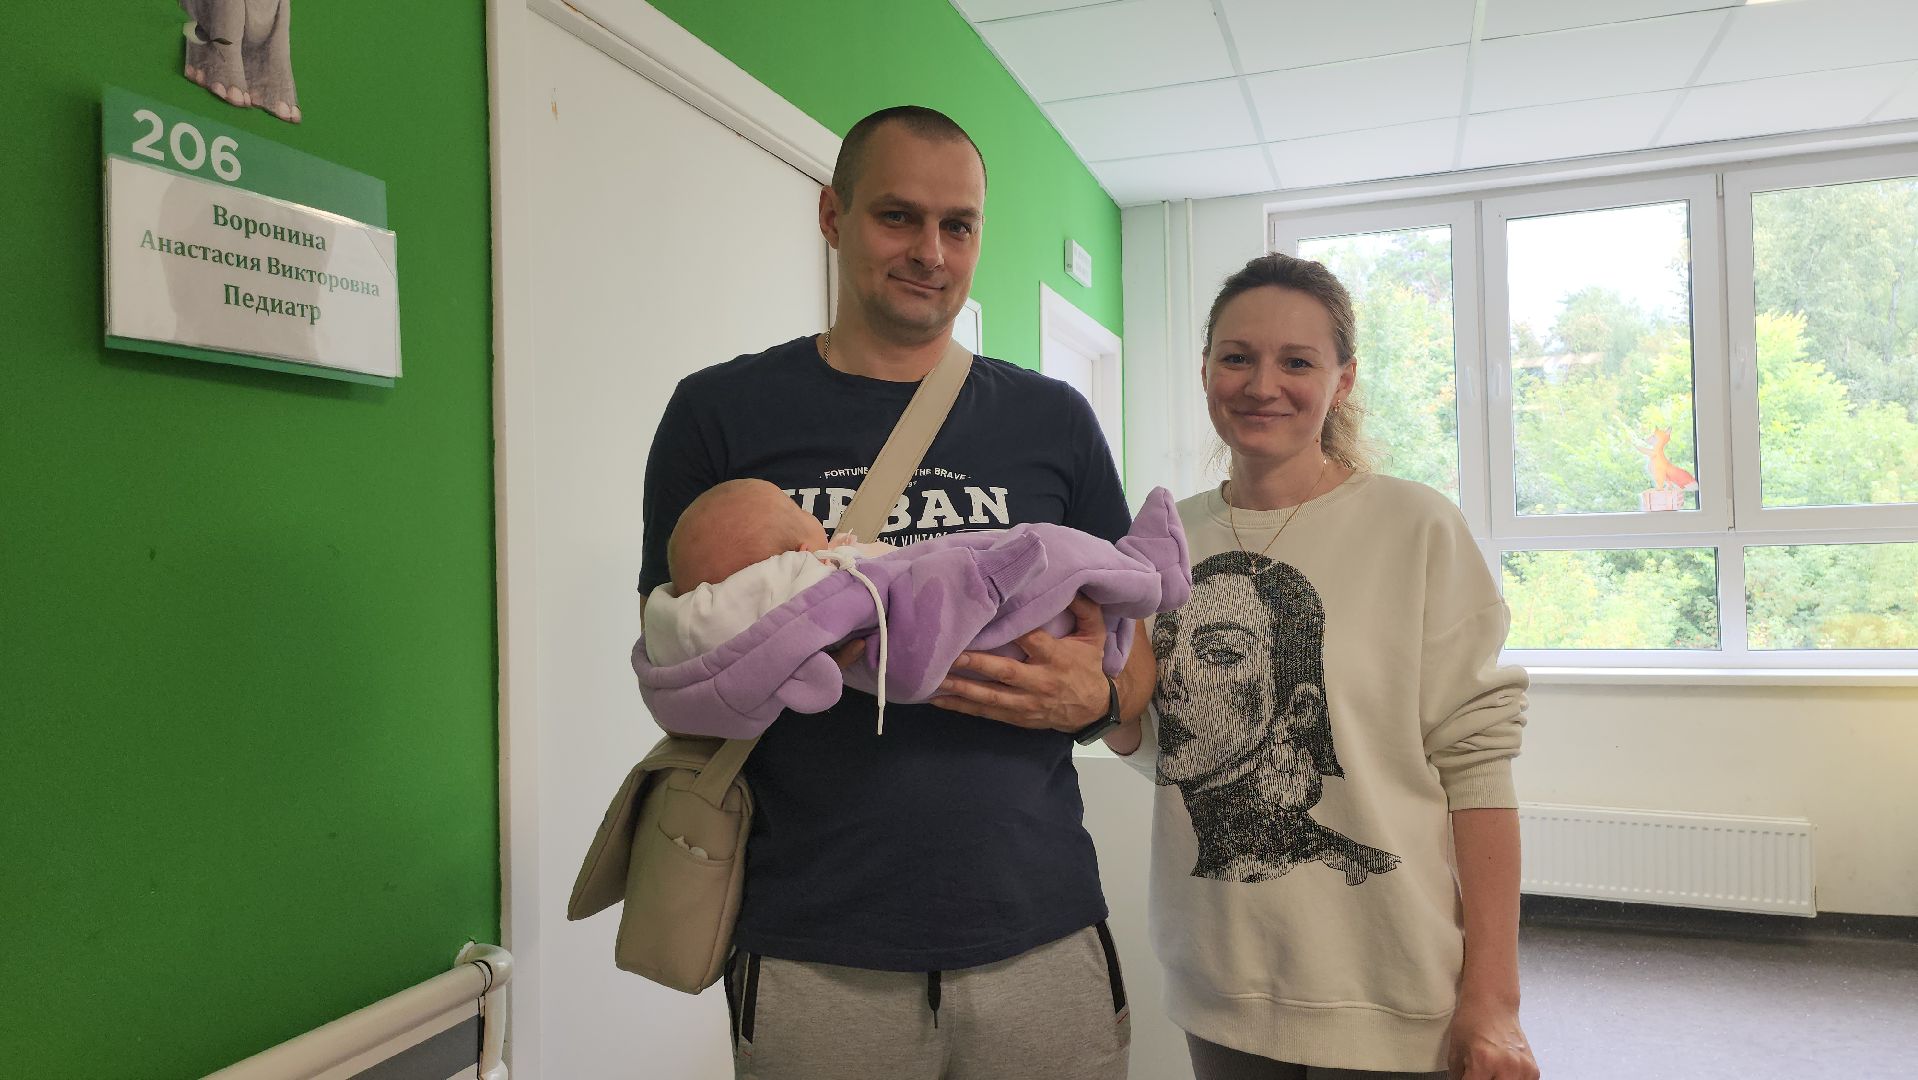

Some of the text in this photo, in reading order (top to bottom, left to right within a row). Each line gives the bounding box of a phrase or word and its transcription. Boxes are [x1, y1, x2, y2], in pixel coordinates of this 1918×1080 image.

[132, 109, 242, 182] 206
[212, 204, 327, 252] Воронина
[140, 229, 380, 297] Анастасия Викторовна
[223, 282, 322, 326] Педиатр
[824, 466, 869, 479] FORTUNE
[934, 467, 967, 480] BRAVE
